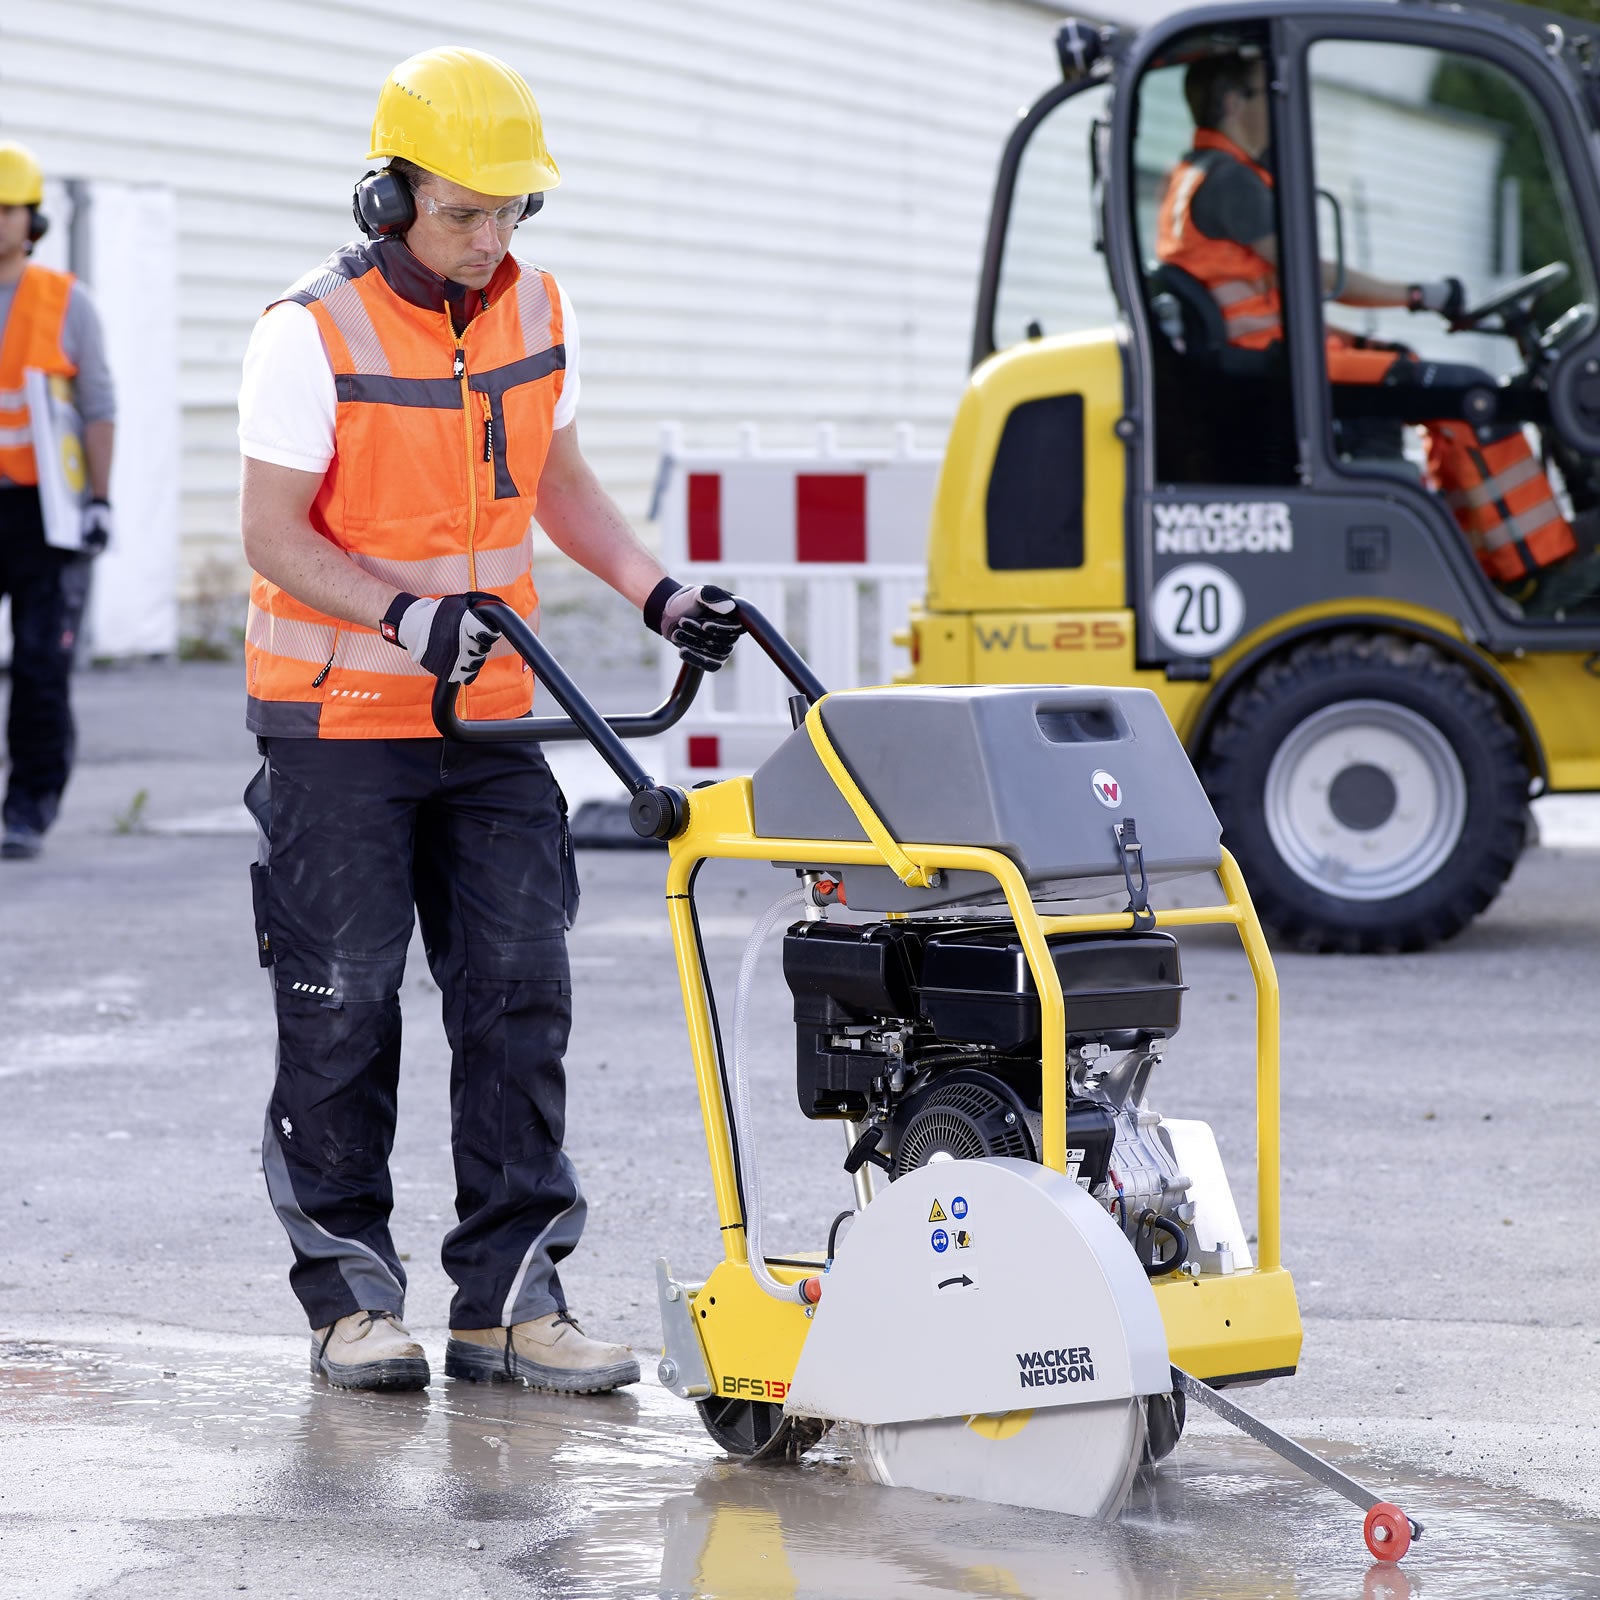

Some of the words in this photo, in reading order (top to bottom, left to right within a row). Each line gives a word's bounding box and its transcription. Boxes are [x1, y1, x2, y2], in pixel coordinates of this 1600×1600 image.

[1153, 502, 1291, 528] WACKER
[1155, 526, 1293, 554] NEUSON
[1173, 583, 1221, 635] 20
[975, 621, 1126, 652] WL25
[1016, 1346, 1093, 1370] WACKER
[1019, 1364, 1095, 1388] NEUSON
